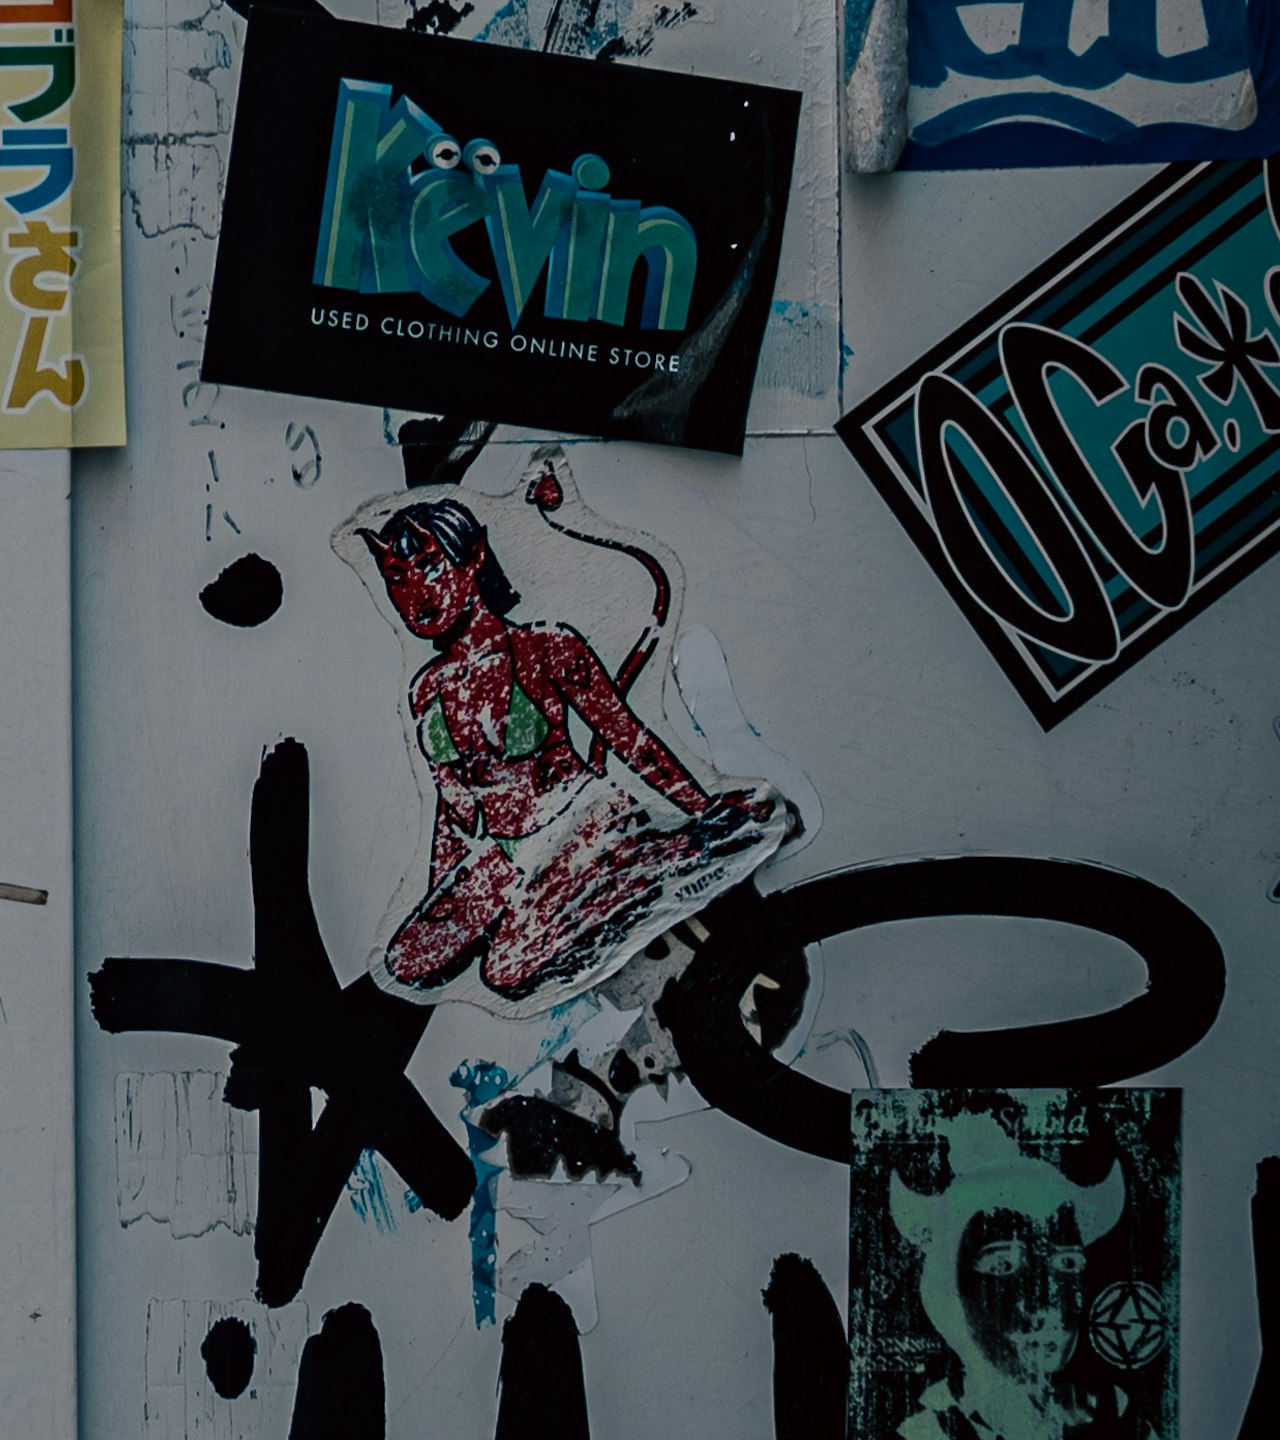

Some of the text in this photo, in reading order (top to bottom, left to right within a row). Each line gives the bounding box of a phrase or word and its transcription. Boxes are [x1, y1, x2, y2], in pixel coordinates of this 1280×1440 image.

[310, 76, 700, 333] Kevin
[310, 306, 681, 373] USED CLOTHING ONLINE STORE
